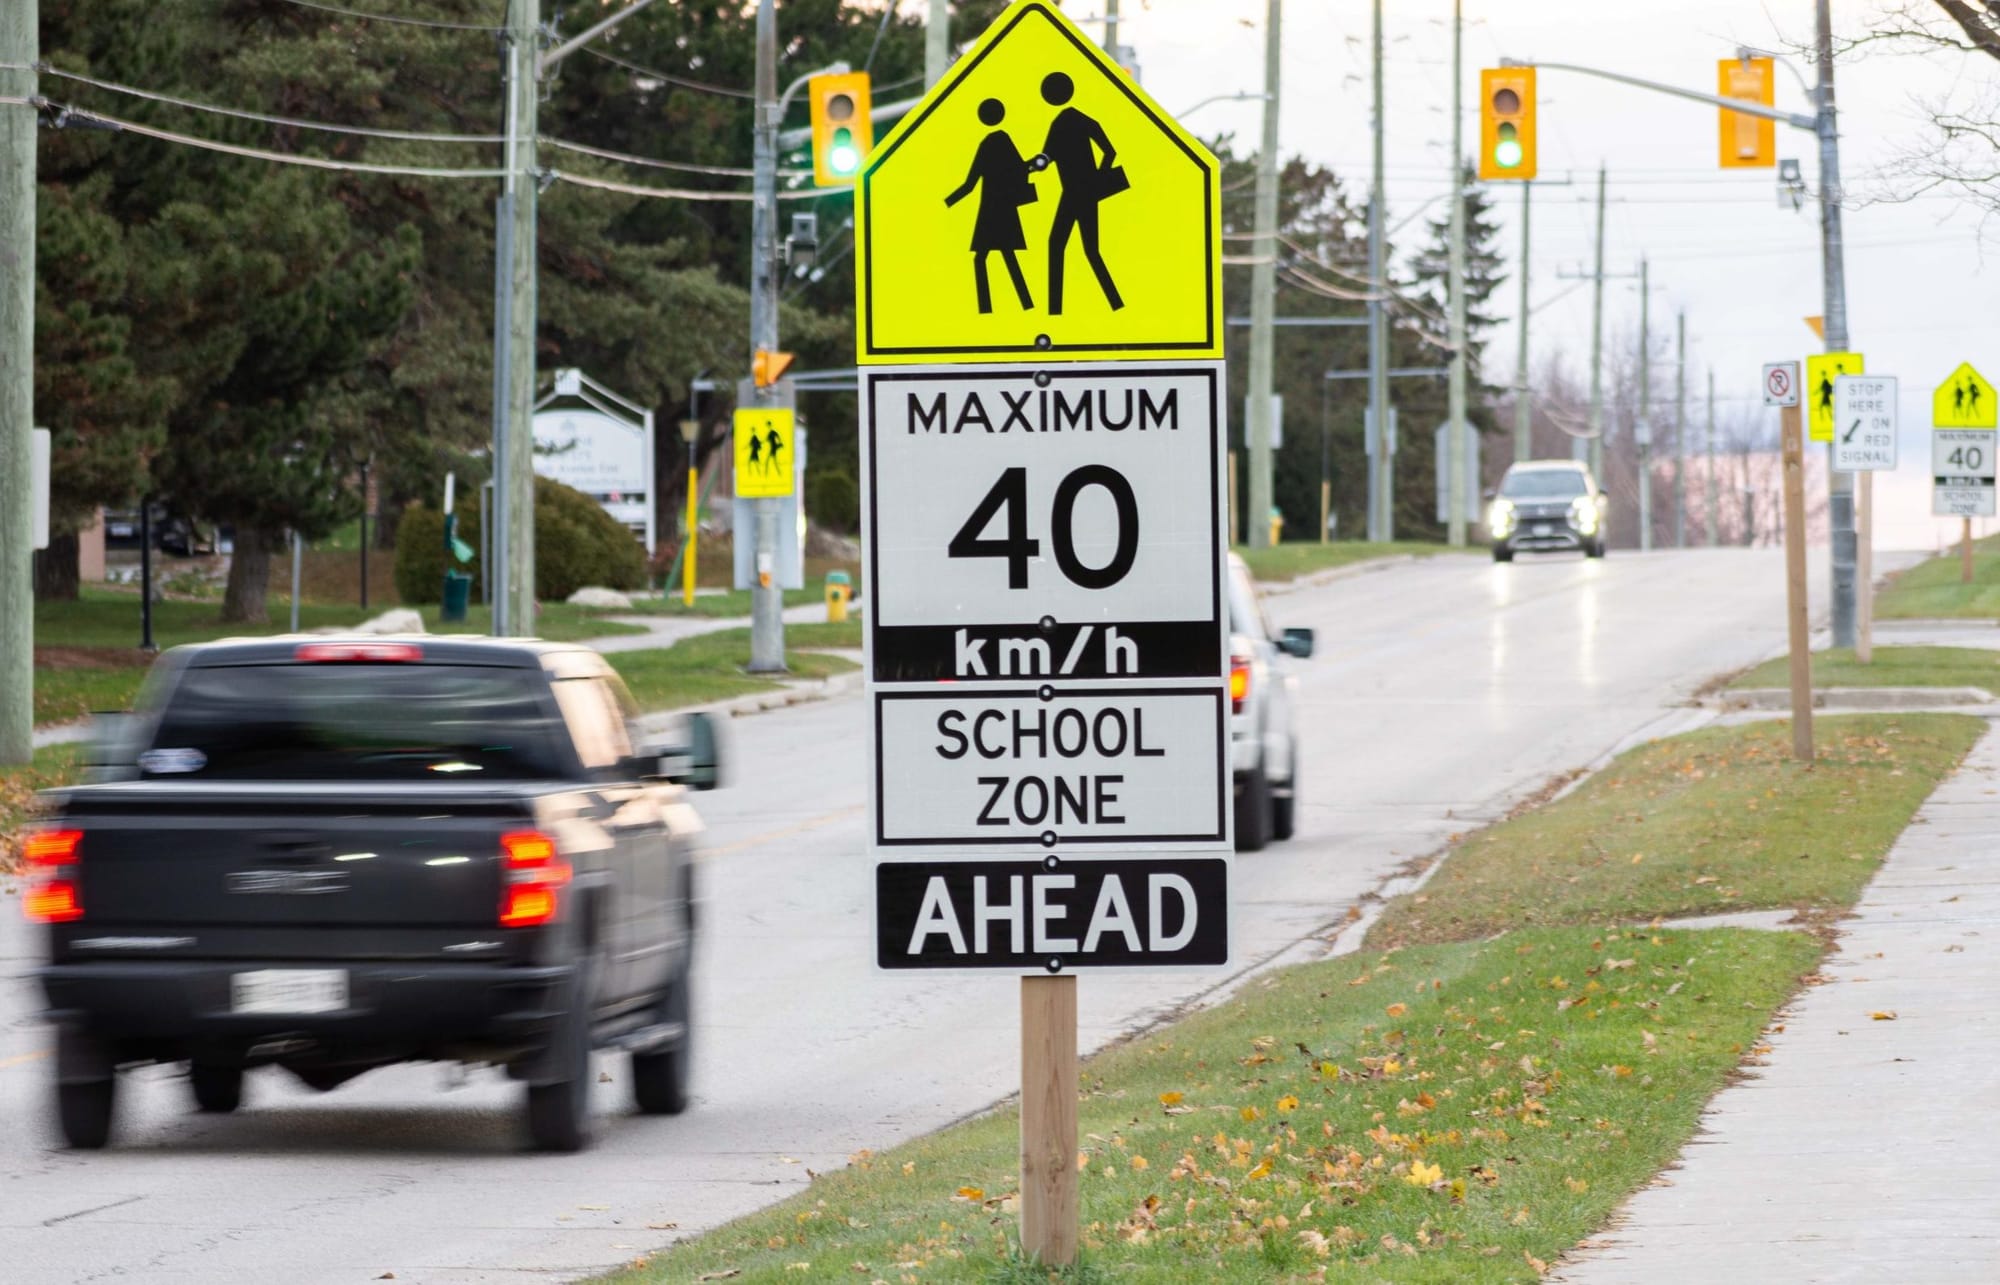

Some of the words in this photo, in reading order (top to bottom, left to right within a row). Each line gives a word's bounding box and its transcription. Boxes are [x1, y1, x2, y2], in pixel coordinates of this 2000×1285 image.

[1848, 384, 1884, 397] STOP
[1848, 400, 1885, 413] HERE
[907, 388, 1179, 435] MAXIMUM
[1871, 417, 1890, 430] ON
[1840, 451, 1890, 463] SIGNAL
[1864, 434, 1891, 447] RED
[1946, 446, 1983, 470] 40
[948, 464, 1140, 590] 40
[954, 625, 1139, 677] km/h
[935, 707, 1165, 760] SCHOOL
[976, 774, 1126, 826] ZONE
[906, 872, 1198, 955] AHEAD
